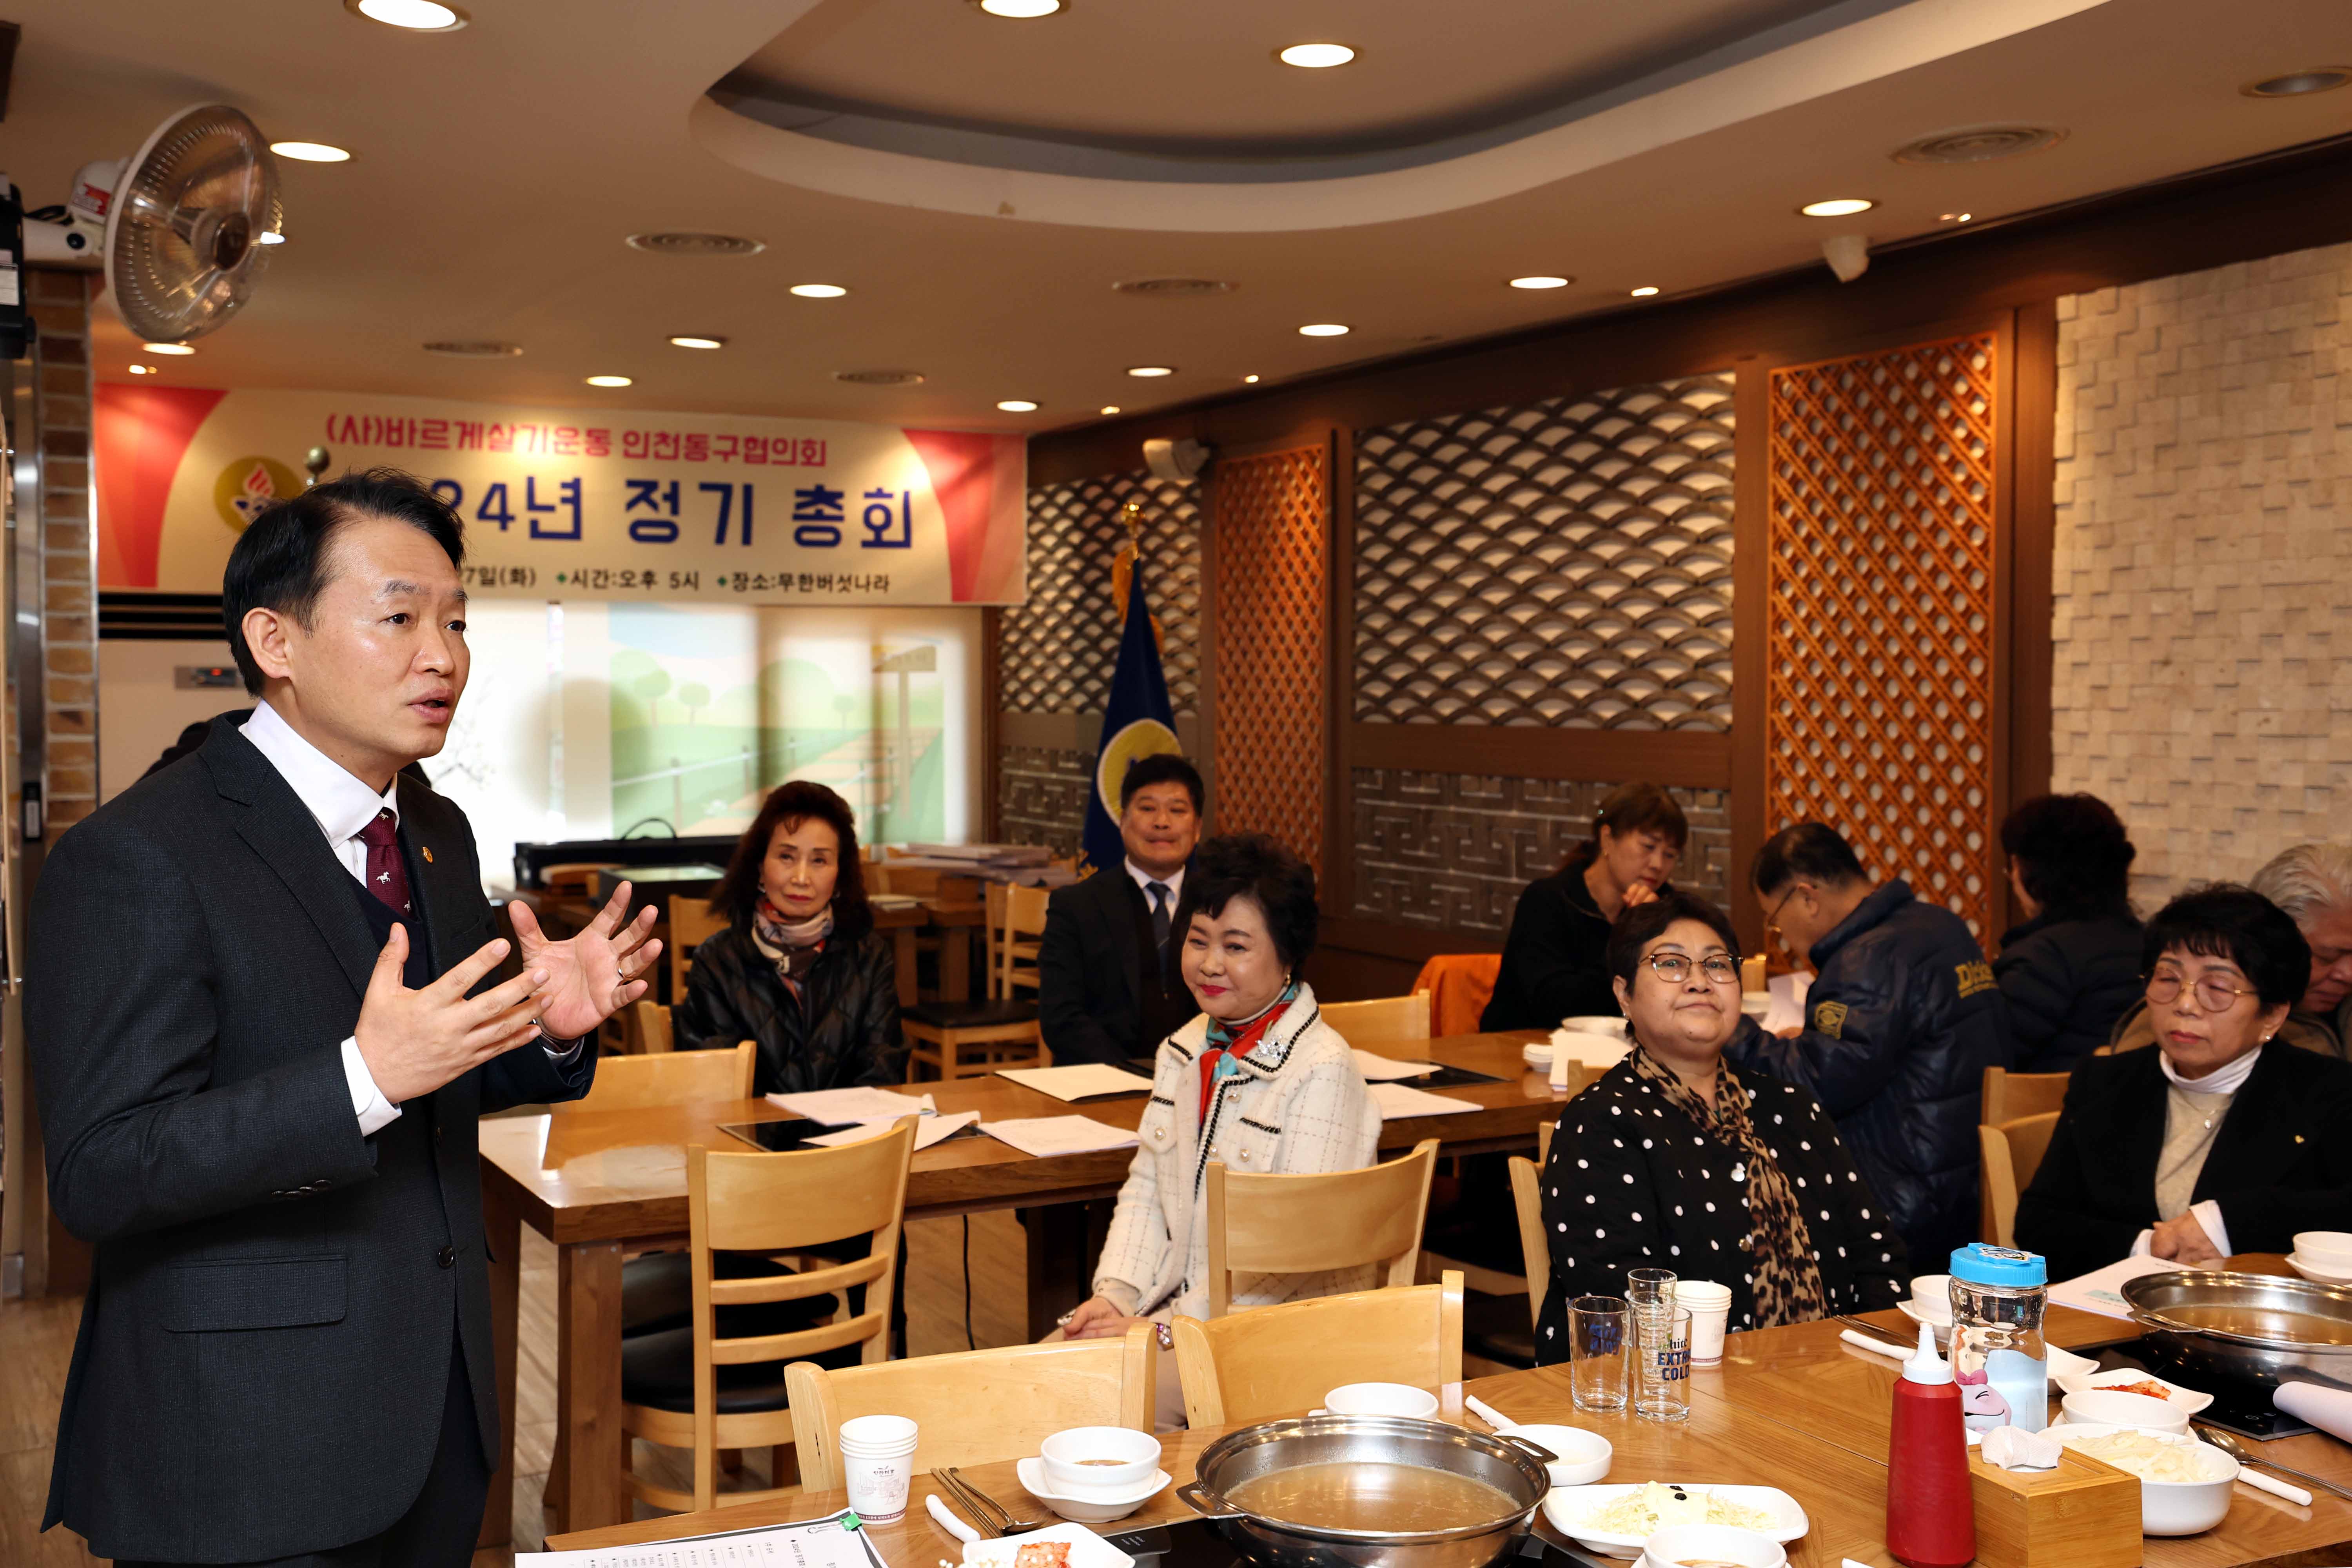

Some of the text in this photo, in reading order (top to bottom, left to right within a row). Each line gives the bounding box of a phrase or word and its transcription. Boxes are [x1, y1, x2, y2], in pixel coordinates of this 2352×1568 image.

[327, 413, 826, 467] (사)바르게살기운동 인천동구협의회
[625, 479, 753, 546] 정기
[791, 484, 912, 549] 총회
[459, 566, 536, 588] 7일(화)
[669, 571, 700, 590] 5시
[732, 572, 890, 593] 장소:무한버섯나라
[1662, 1365, 1690, 1381] COLD
